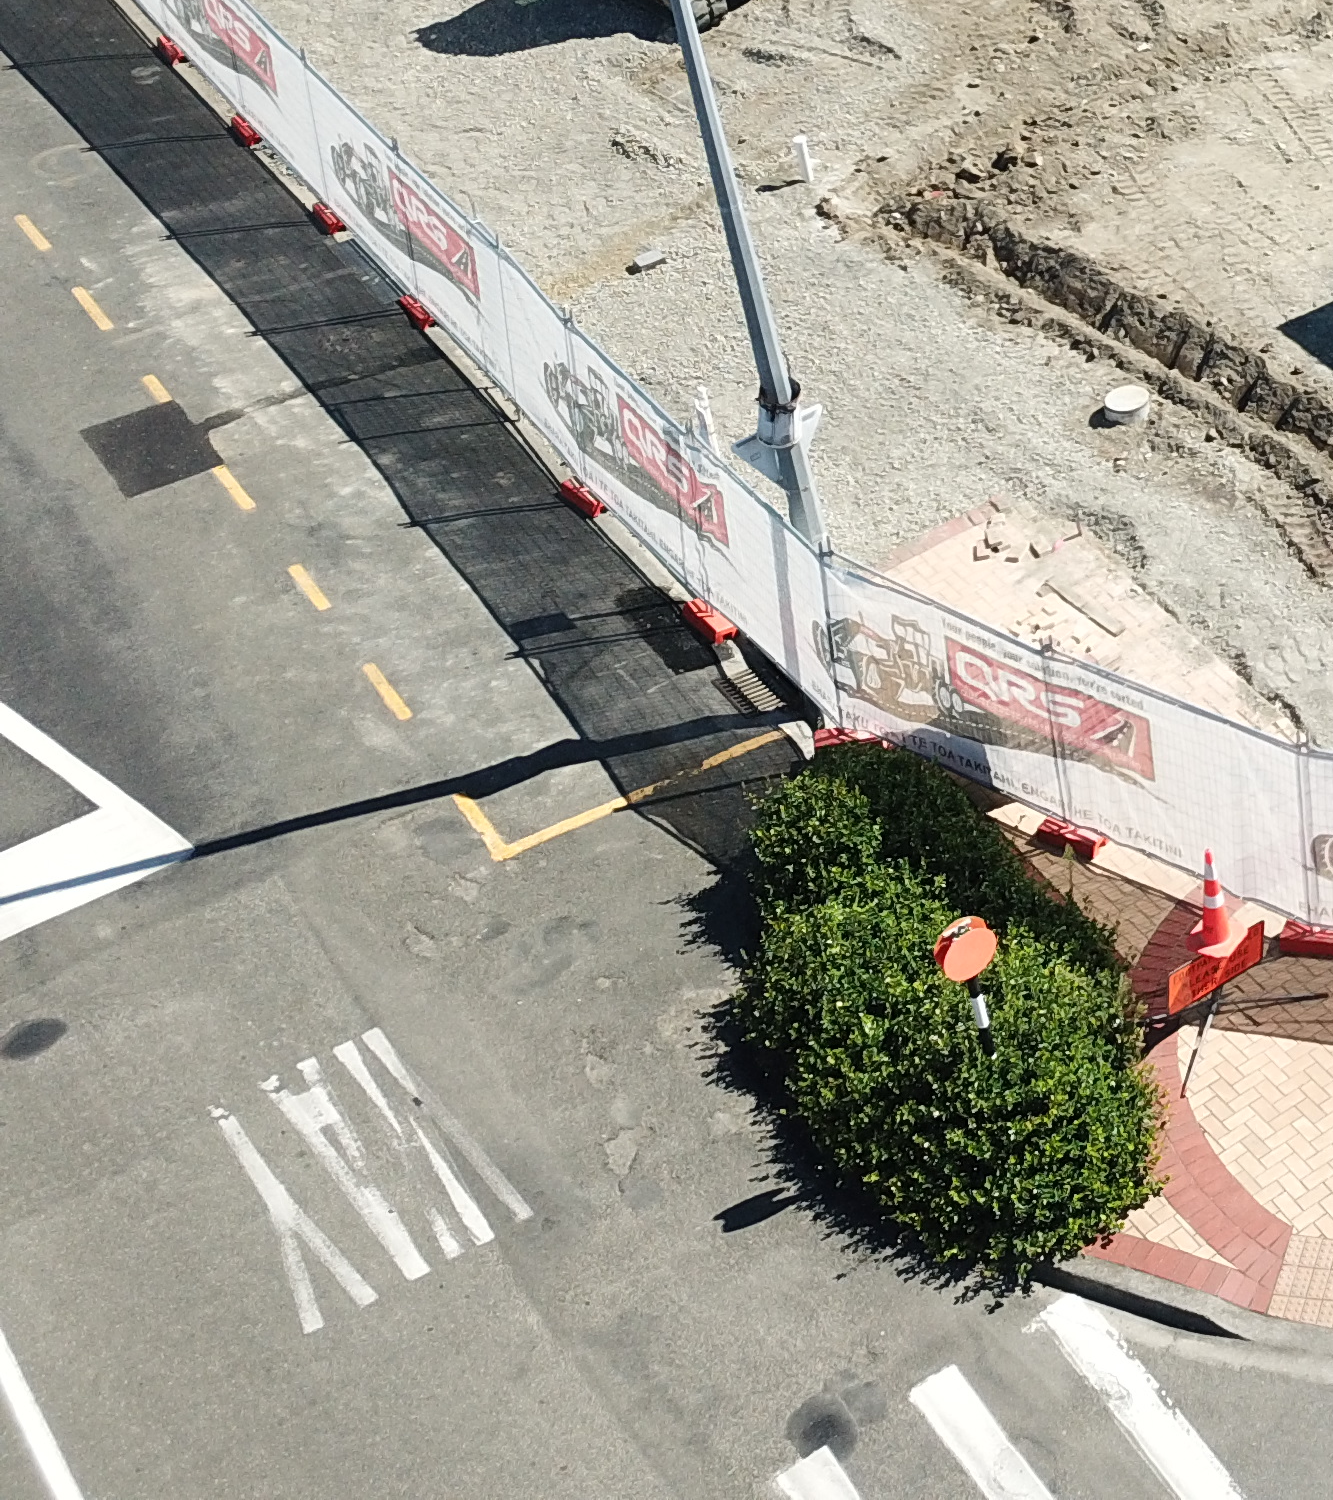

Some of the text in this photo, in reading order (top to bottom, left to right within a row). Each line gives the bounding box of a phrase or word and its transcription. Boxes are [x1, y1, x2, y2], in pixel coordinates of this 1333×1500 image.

[392, 178, 447, 251] QRS
[622, 407, 690, 493] QRS
[954, 651, 1085, 728] QRS
[1073, 808, 1094, 820] HE
[1225, 960, 1247, 978] SIDE
